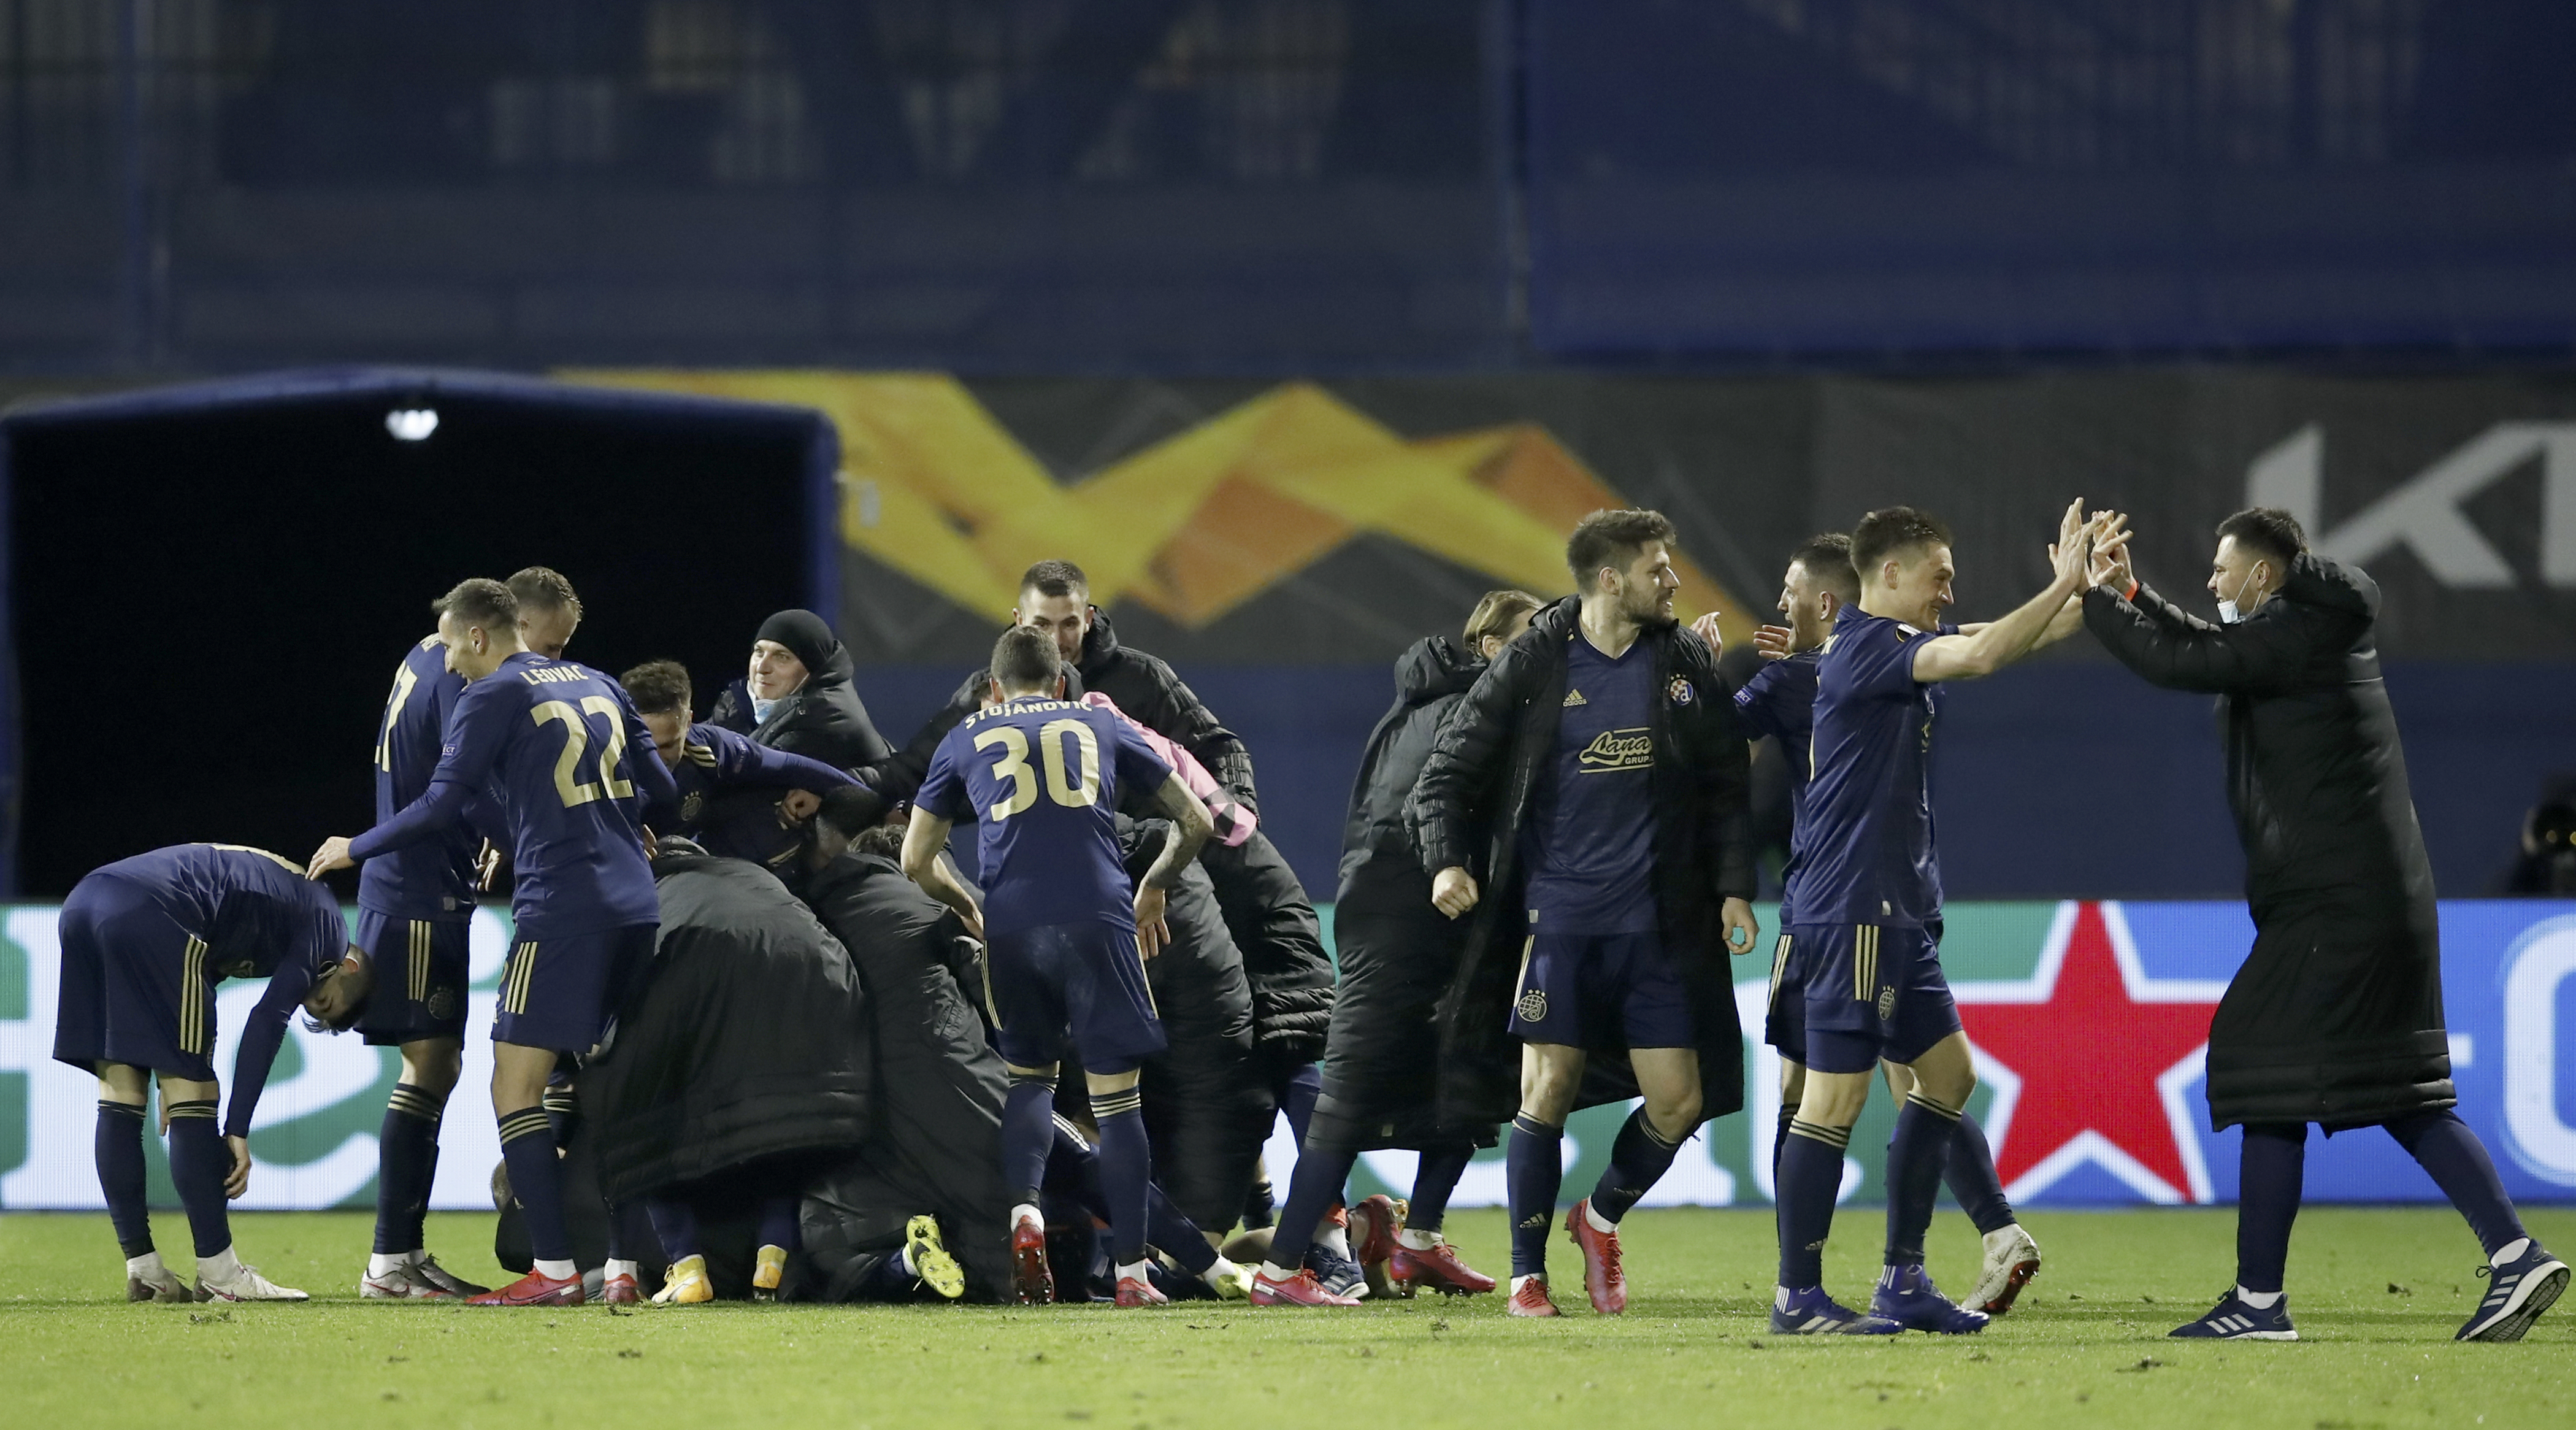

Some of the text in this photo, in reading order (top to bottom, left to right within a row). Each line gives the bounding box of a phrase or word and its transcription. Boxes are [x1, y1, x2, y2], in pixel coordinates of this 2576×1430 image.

[375, 659, 418, 772] 7
[519, 664, 589, 686] LEOVAC
[530, 696, 634, 809] 22
[973, 718, 1100, 822] 30
[1579, 731, 1652, 766] Lana
